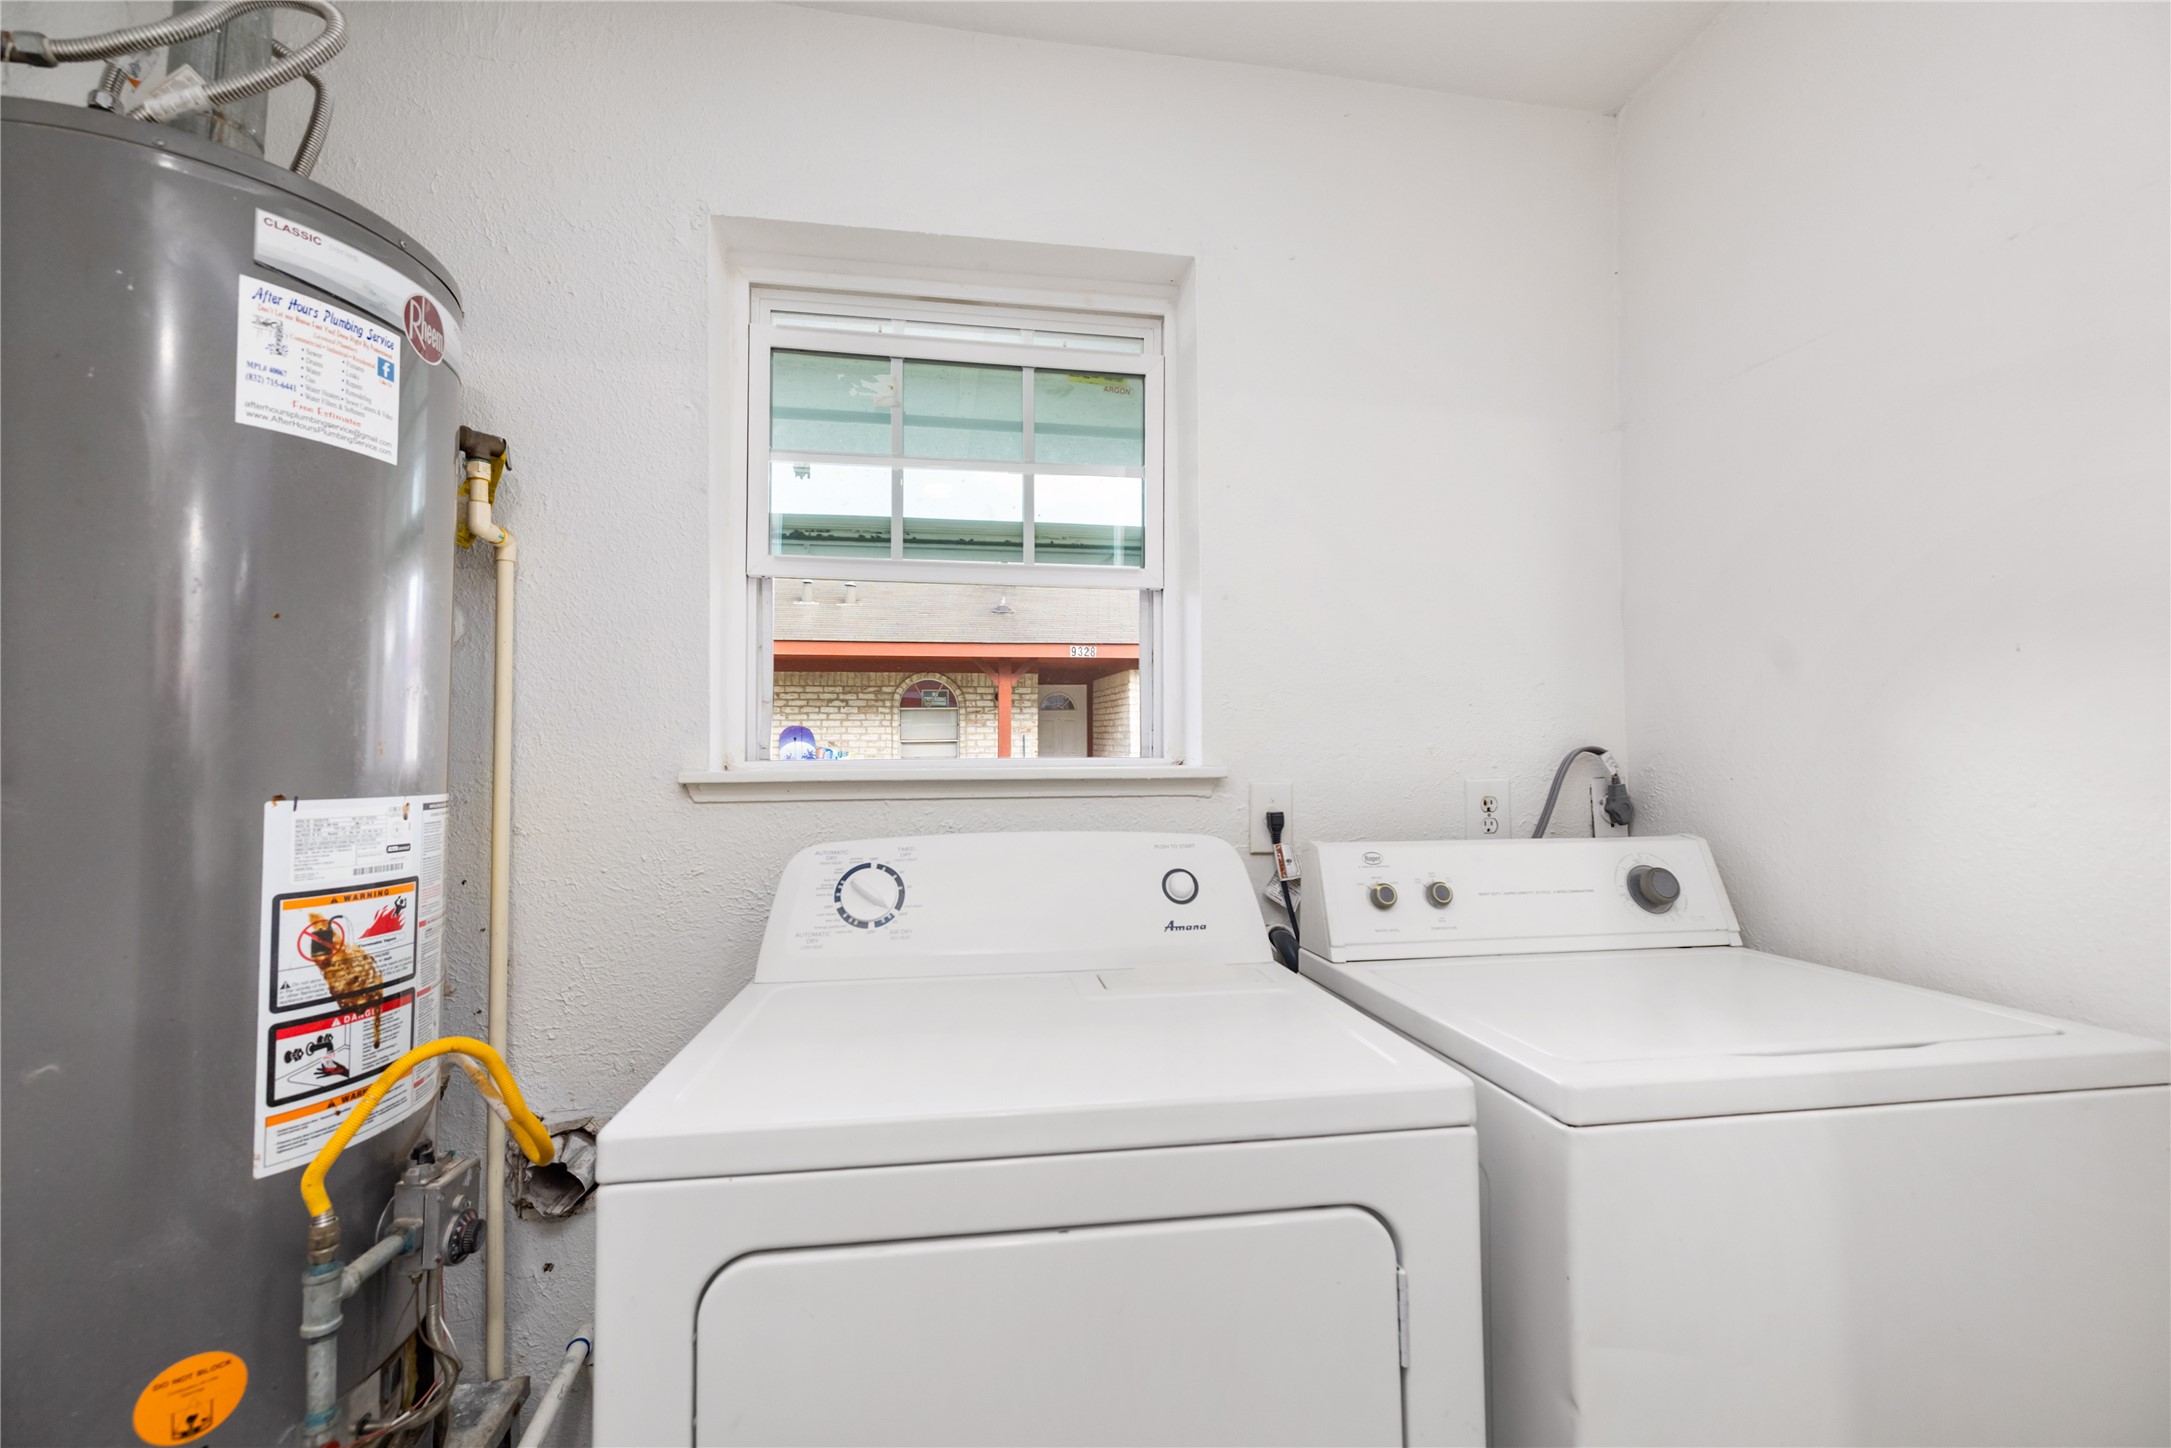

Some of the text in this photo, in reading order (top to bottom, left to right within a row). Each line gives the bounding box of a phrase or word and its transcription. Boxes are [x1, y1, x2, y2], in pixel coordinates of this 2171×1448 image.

[263, 217, 323, 247] CLASSIC
[252, 287, 395, 351] After Hours Plumbing Service
[409, 296, 444, 355] Rheem
[265, 376, 297, 393] 715-6441
[1103, 385, 1132, 397] ARGON
[244, 401, 393, 449] afterhoursplumbingservice@gmail.com
[246, 411, 393, 457] www.AfterHoursPlumbingService.com
[1071, 646, 1096, 657] 9328
[344, 889, 390, 902] WARNING
[1164, 920, 1206, 932] Amana
[341, 1087, 369, 1103] WARN
